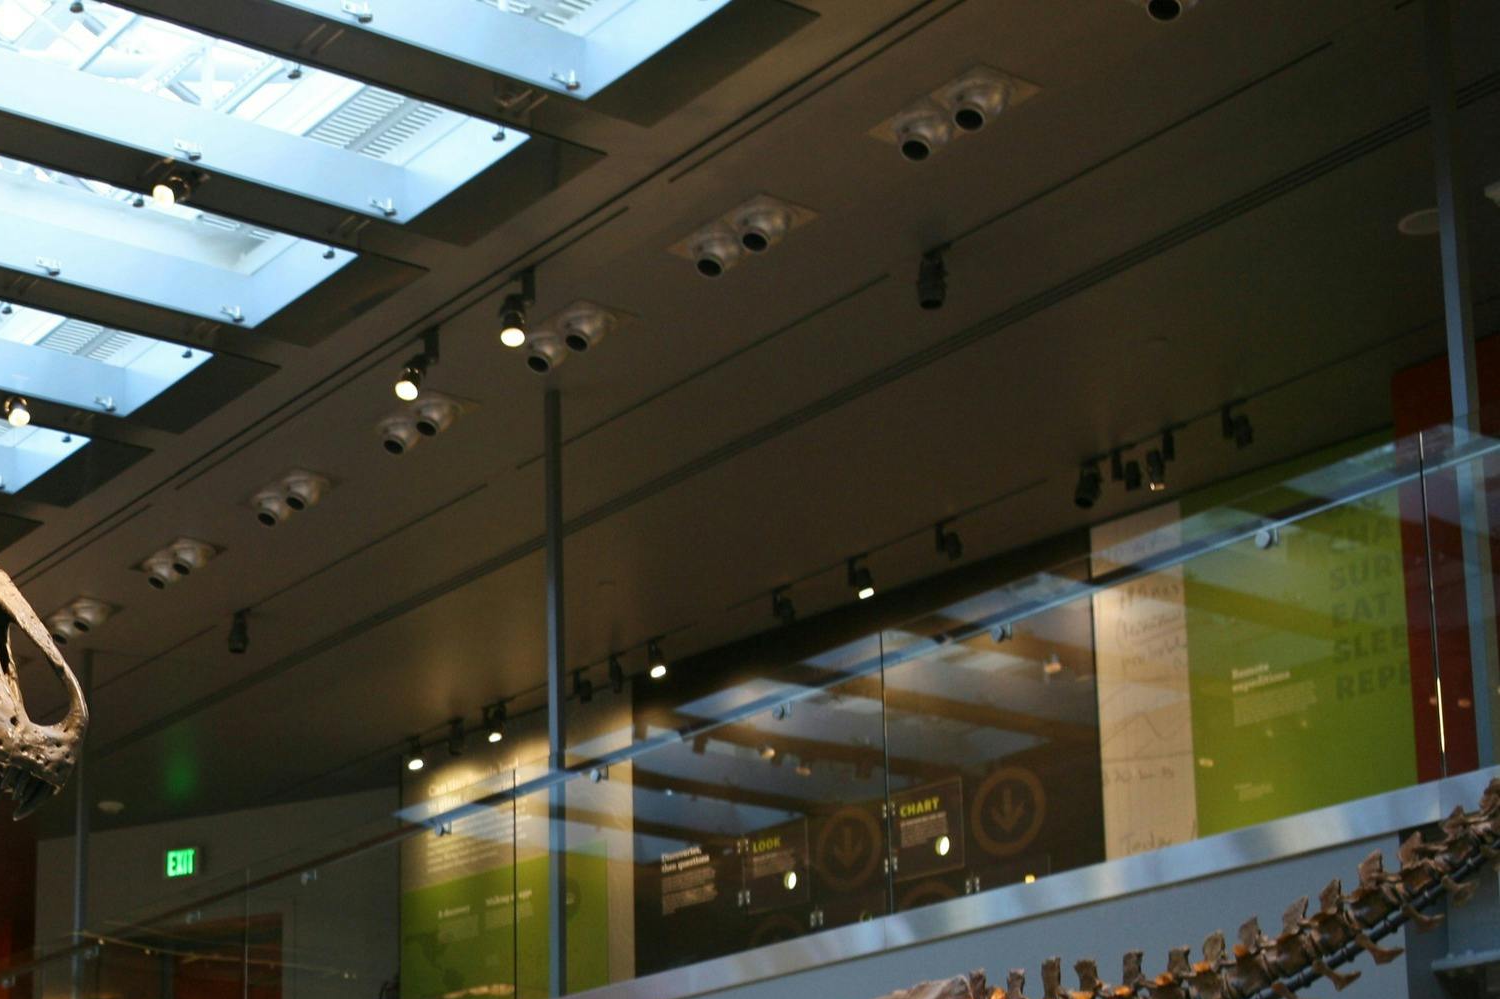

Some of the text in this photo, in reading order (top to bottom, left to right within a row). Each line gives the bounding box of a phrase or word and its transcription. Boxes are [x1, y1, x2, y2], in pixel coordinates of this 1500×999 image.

[1331, 592, 1391, 624] EAT
[900, 796, 940, 818] CHART
[753, 837, 781, 853] LOOK
[167, 848, 195, 877] EXIT
